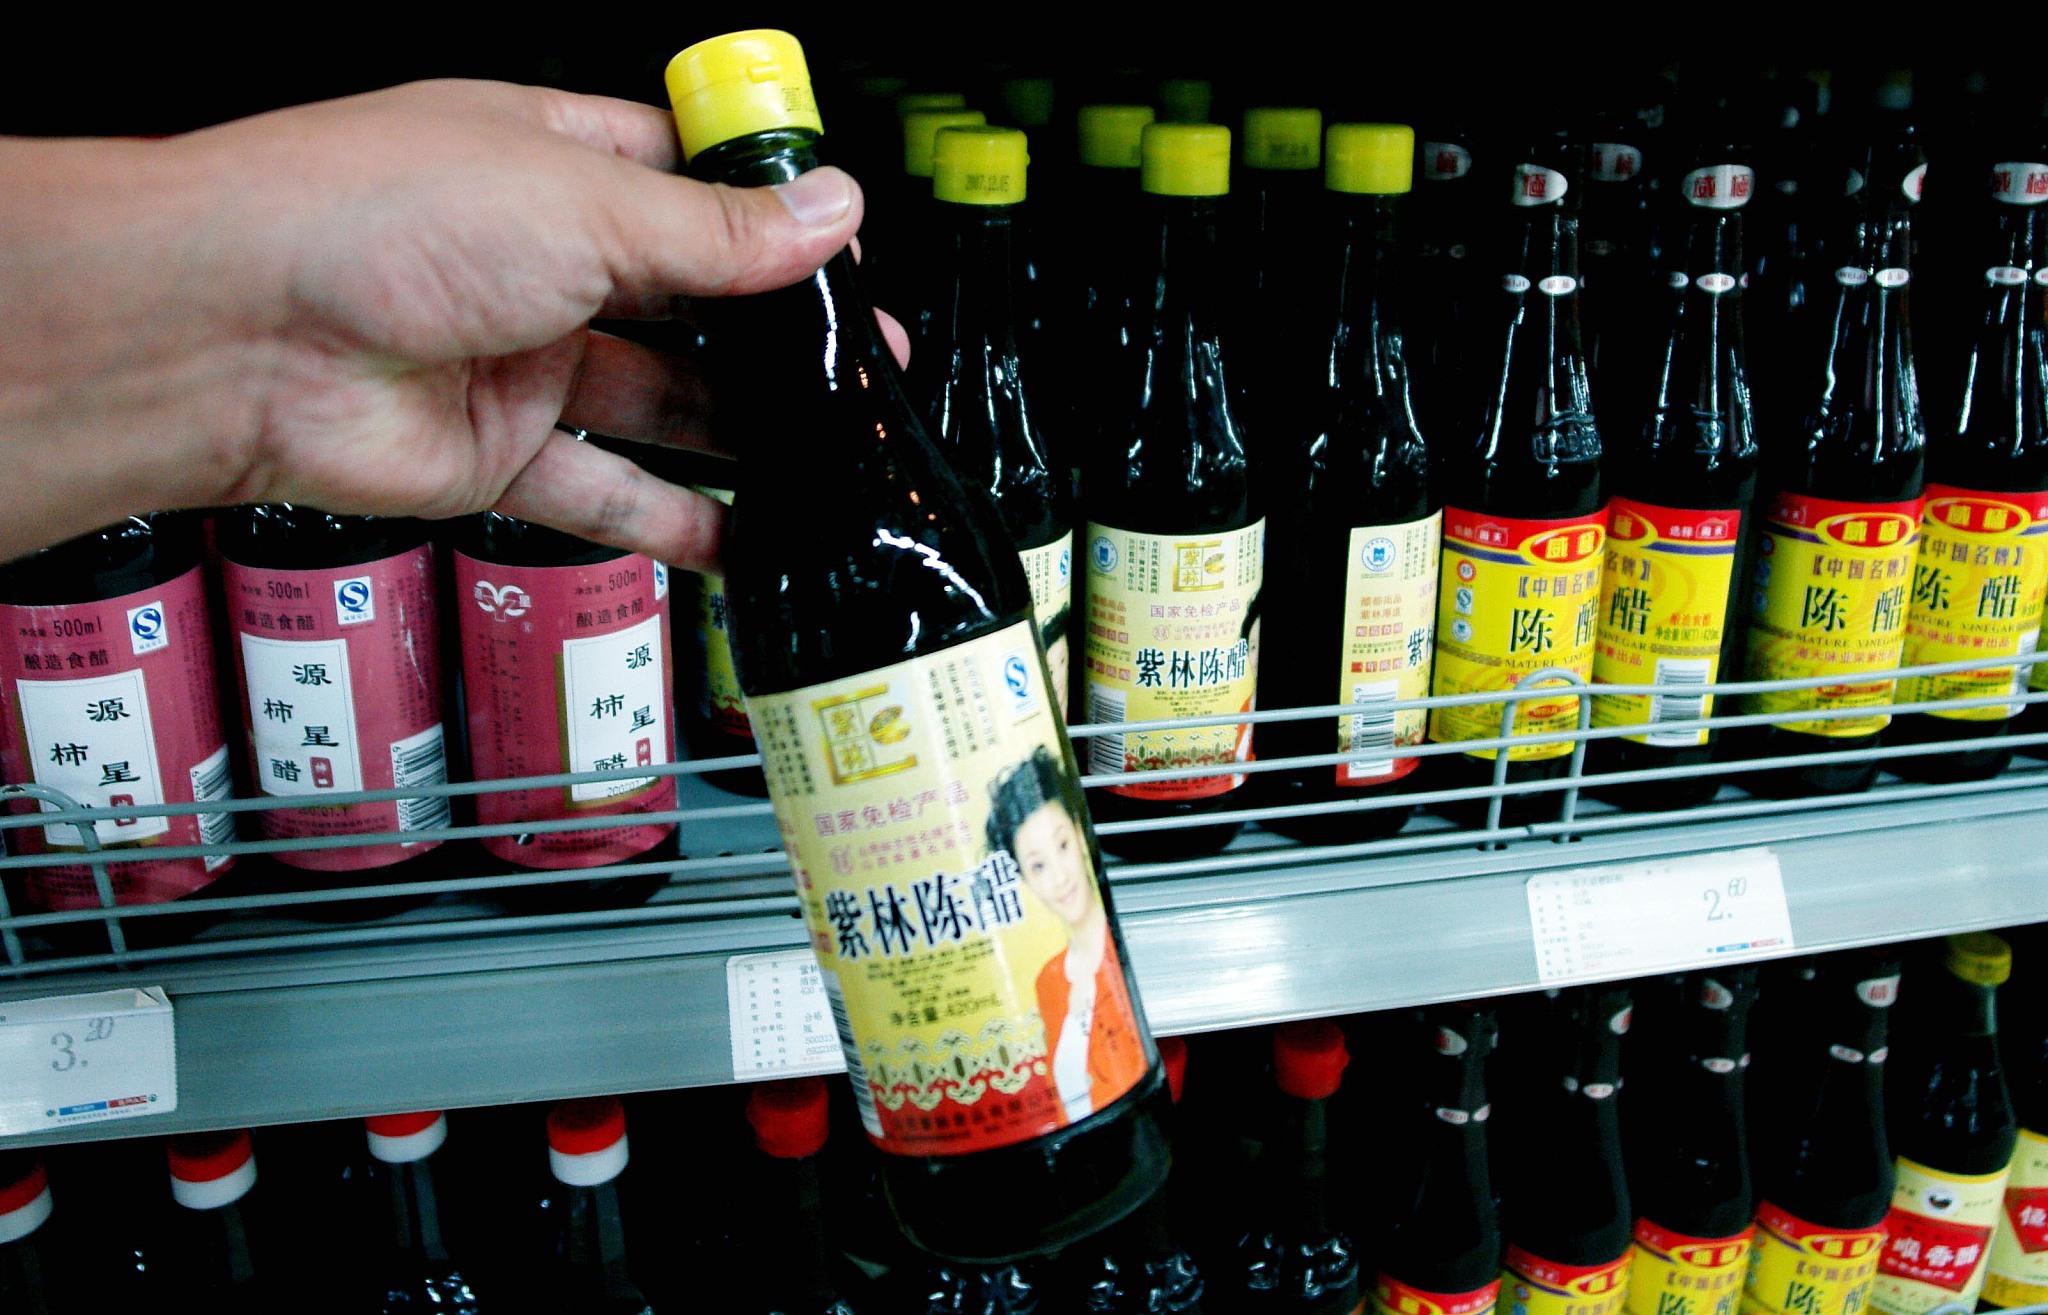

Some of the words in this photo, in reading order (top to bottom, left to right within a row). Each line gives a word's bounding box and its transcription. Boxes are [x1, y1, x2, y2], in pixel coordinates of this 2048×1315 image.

[1609, 586, 1652, 636] 醋
[1136, 640, 1250, 689] 紫林陈醋
[814, 780, 969, 838] 国家免检产品
[825, 857, 1022, 958] 紫林陈醋
